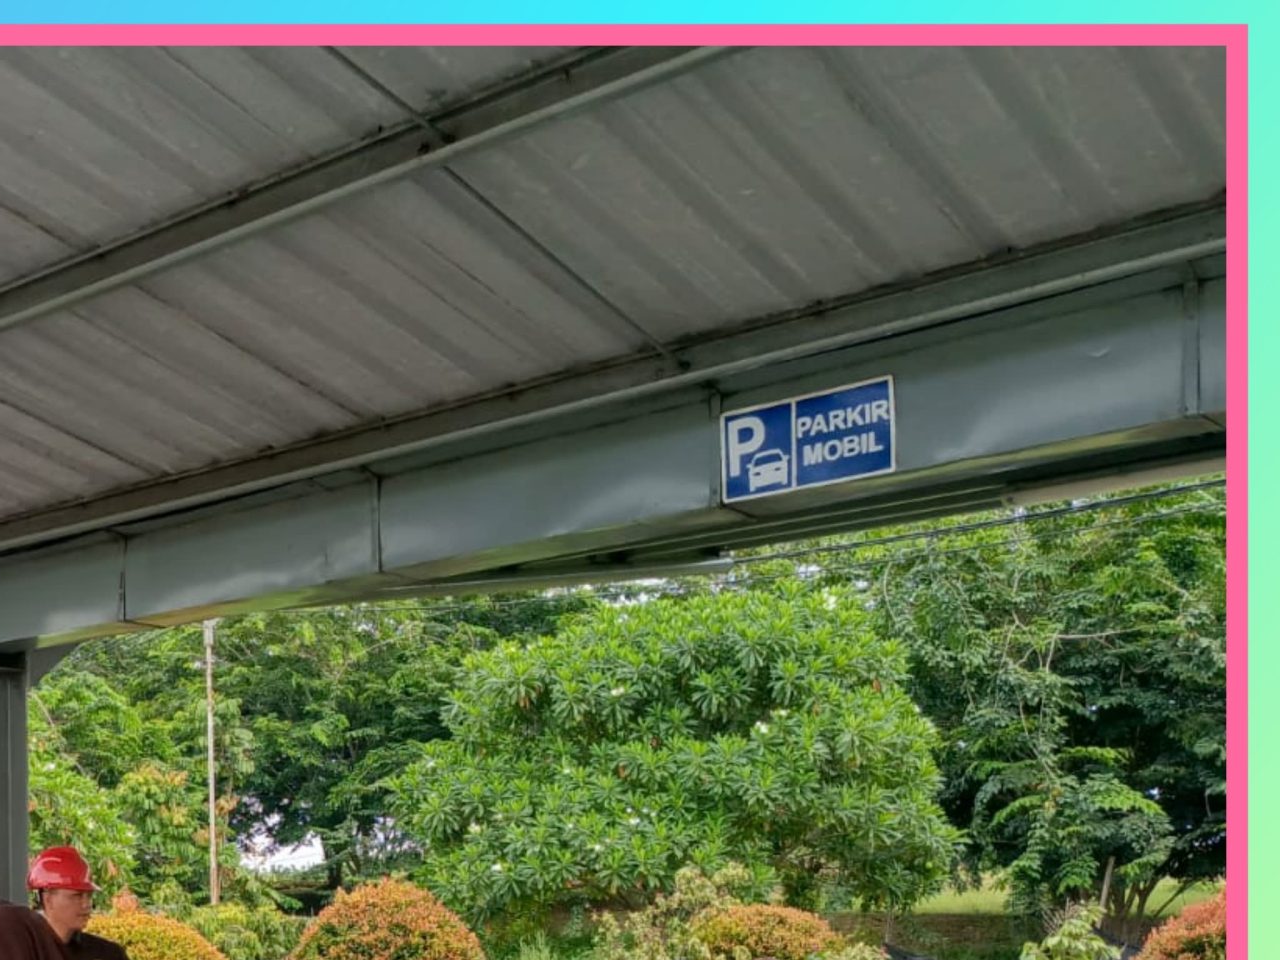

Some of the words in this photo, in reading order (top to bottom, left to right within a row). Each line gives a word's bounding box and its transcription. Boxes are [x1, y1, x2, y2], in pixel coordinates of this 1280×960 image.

[797, 400, 889, 438] PARKIR
[727, 416, 766, 477] P
[803, 431, 884, 466] MOBIL
